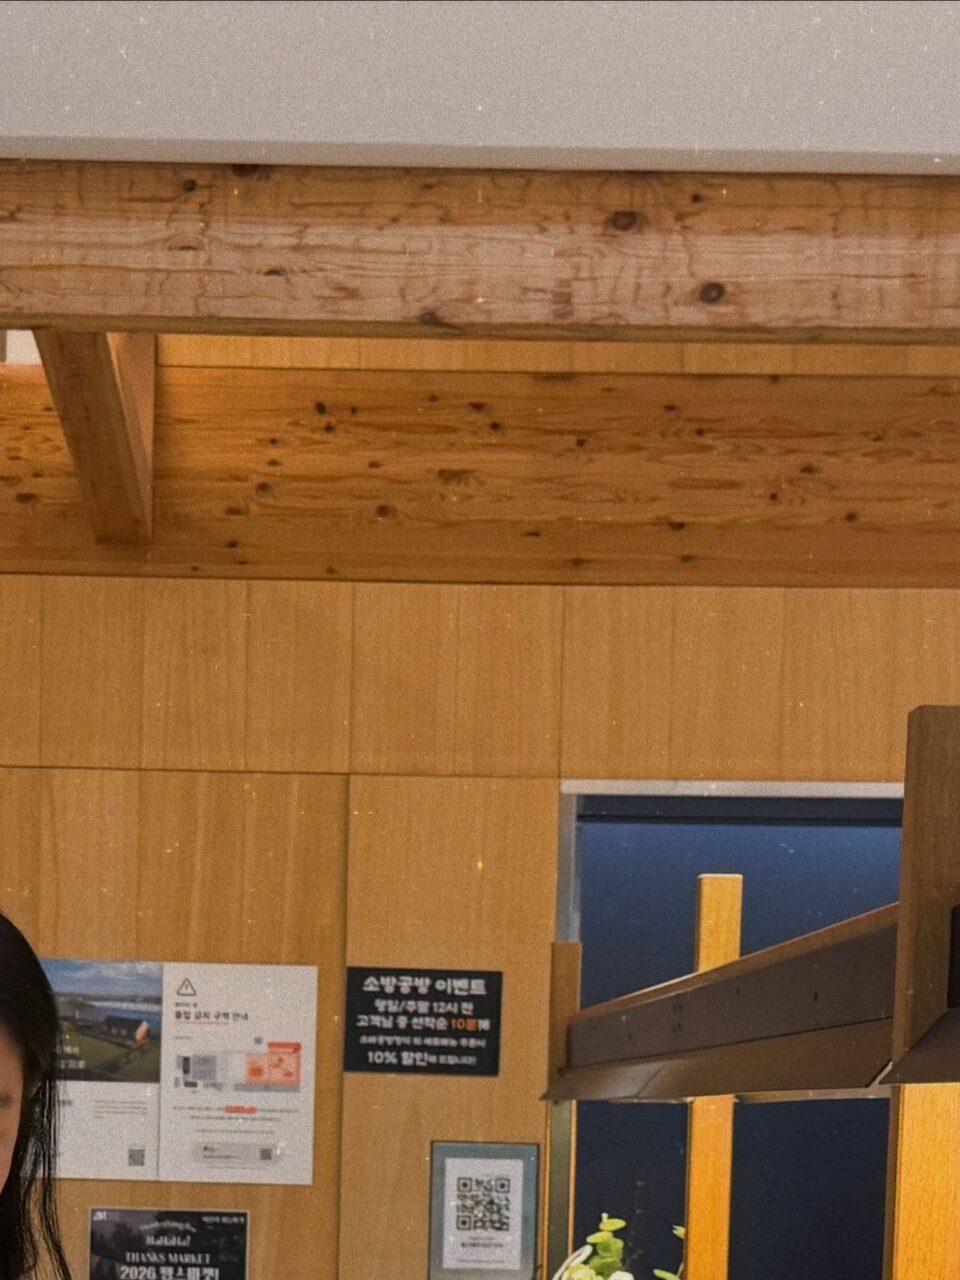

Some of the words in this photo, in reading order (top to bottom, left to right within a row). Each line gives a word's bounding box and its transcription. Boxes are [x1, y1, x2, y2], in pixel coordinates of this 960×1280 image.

[435, 977, 487, 995] 이벤트
[433, 1001, 458, 1014] 12시
[356, 1015, 393, 1028] 고객님
[411, 1016, 448, 1030] 선착순
[367, 1051, 398, 1065] 10%
[120, 1266, 157, 1280] 2026
